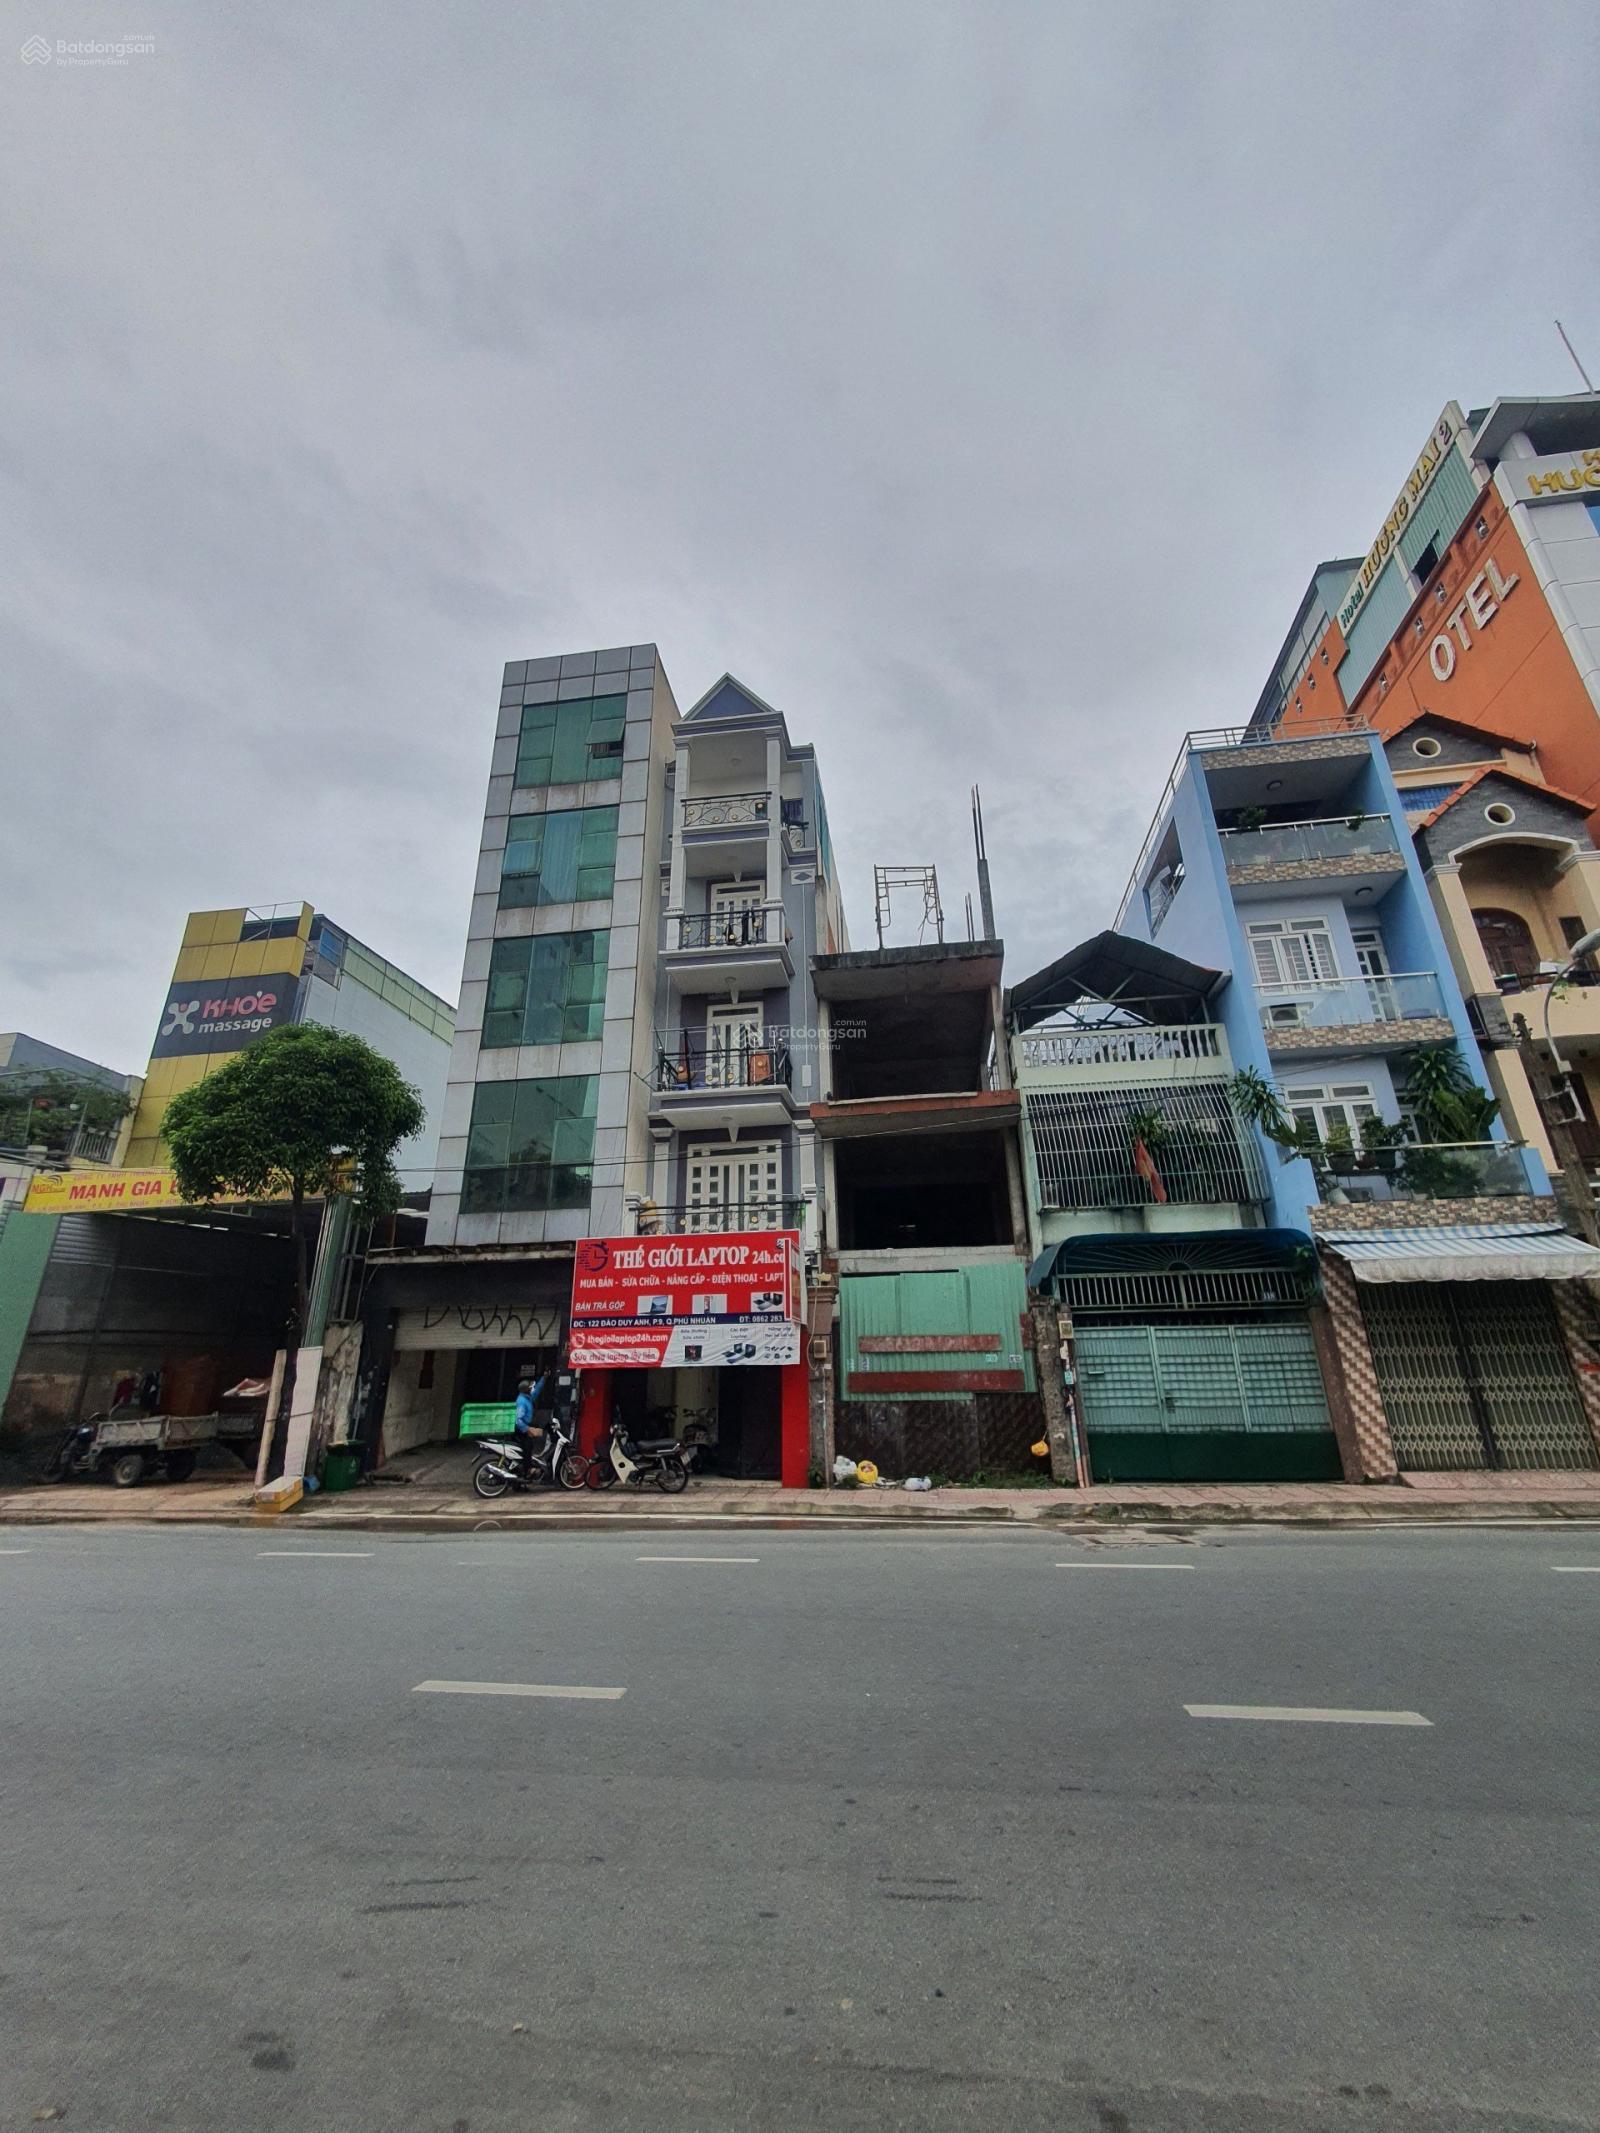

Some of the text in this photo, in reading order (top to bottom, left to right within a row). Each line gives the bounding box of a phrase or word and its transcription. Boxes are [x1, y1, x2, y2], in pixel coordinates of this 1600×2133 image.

[1341, 582, 1364, 628] Hotel
[1406, 437, 1442, 502] MAI
[1439, 420, 1453, 445] 2
[1430, 558, 1520, 681] OTEL
[198, 1017, 272, 1033] massage
[69, 1183, 126, 1201] MẠNH
[131, 1180, 162, 1197] GIA
[648, 1243, 684, 1268] GIỚI
[686, 1246, 749, 1267] LAPTOP
[580, 1278, 596, 1288] MUA
[598, 1275, 614, 1288] BÁN
[712, 1271, 731, 1285] ĐIỆN
[733, 1273, 757, 1284] THOẠI
